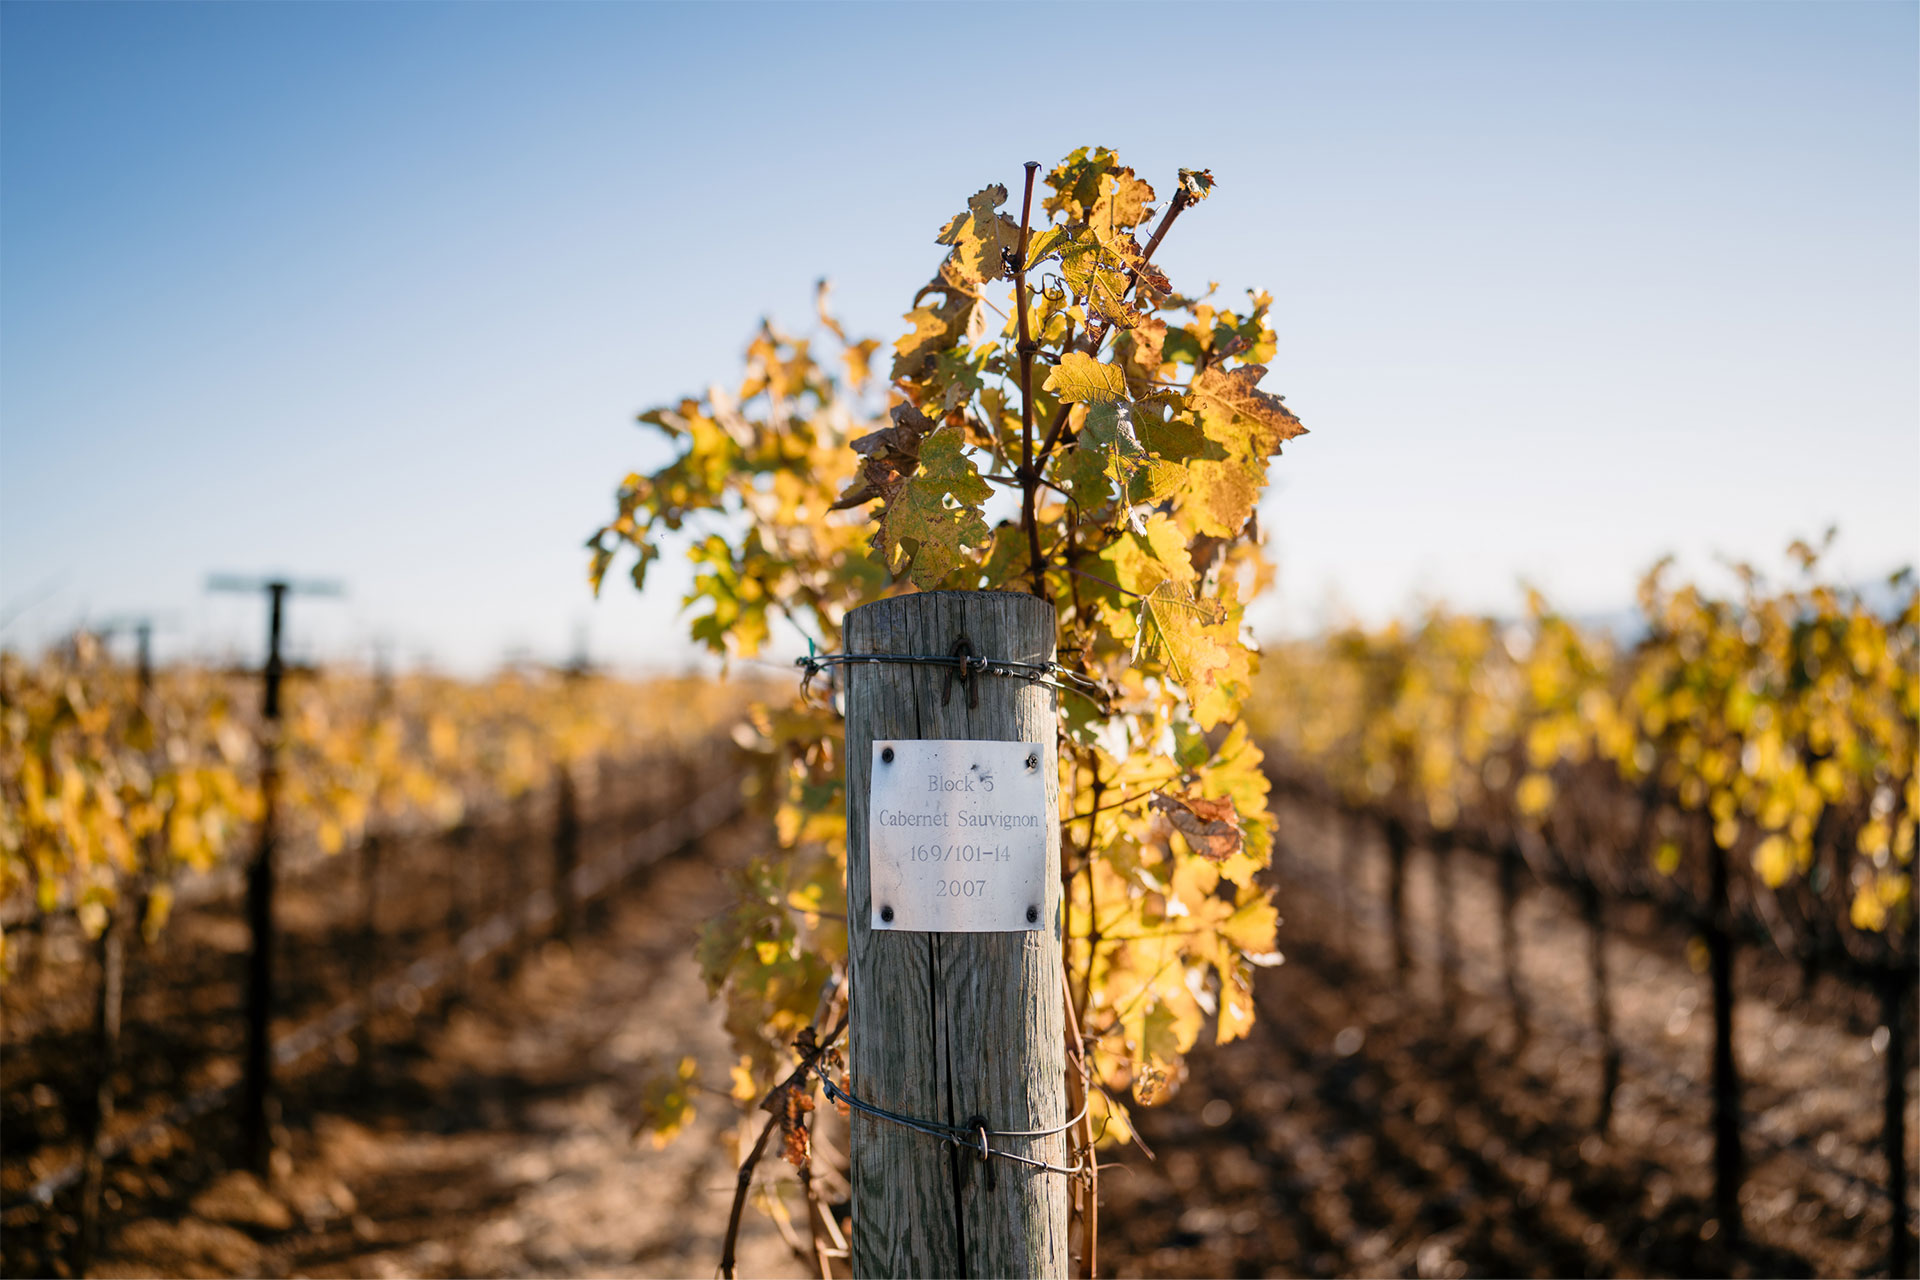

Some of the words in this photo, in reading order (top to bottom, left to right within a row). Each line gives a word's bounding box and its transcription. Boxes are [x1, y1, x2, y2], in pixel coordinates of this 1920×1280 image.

[928, 775, 975, 792] Block
[983, 775, 994, 792] 5
[879, 809, 949, 827] Cabernet
[957, 810, 1039, 830] Sauvignon
[910, 844, 1011, 862] 169/101-14
[936, 879, 987, 897] 2007
